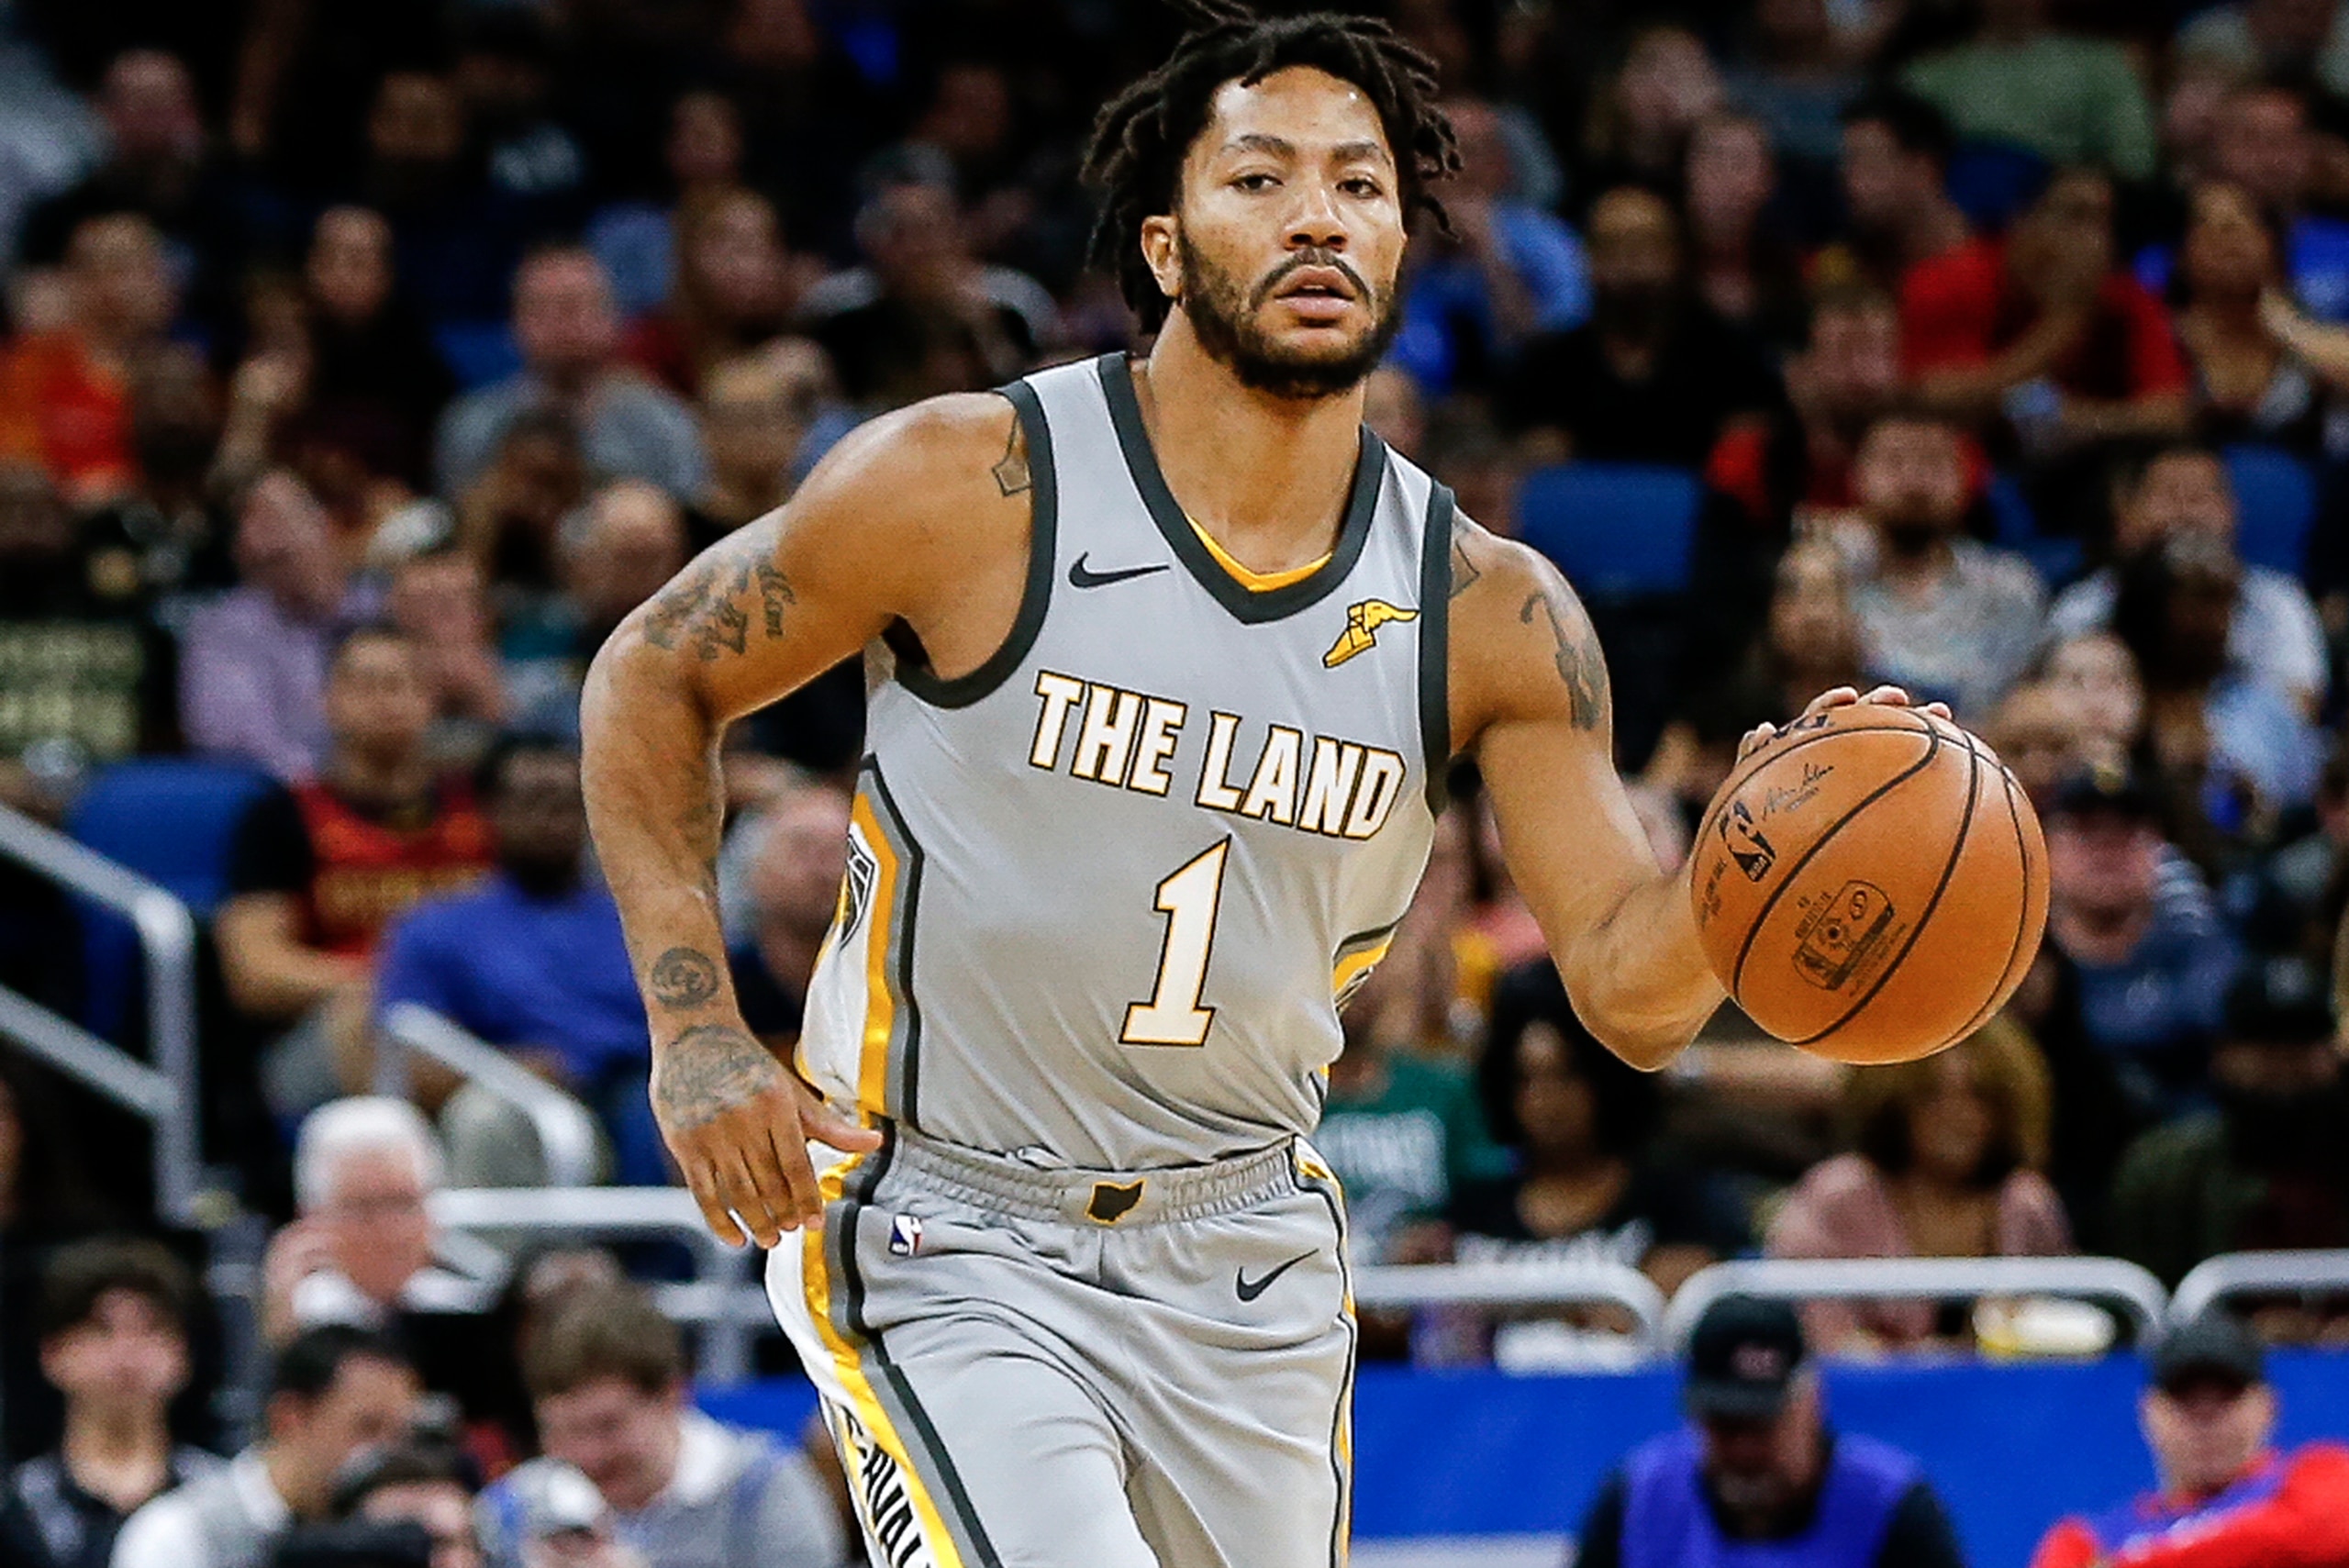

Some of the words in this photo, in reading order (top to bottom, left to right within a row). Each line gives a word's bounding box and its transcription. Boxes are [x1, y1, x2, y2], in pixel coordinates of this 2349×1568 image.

[1029, 669, 1189, 797] THE
[1195, 710, 1407, 840] LAND
[1118, 833, 1232, 1046] 1
